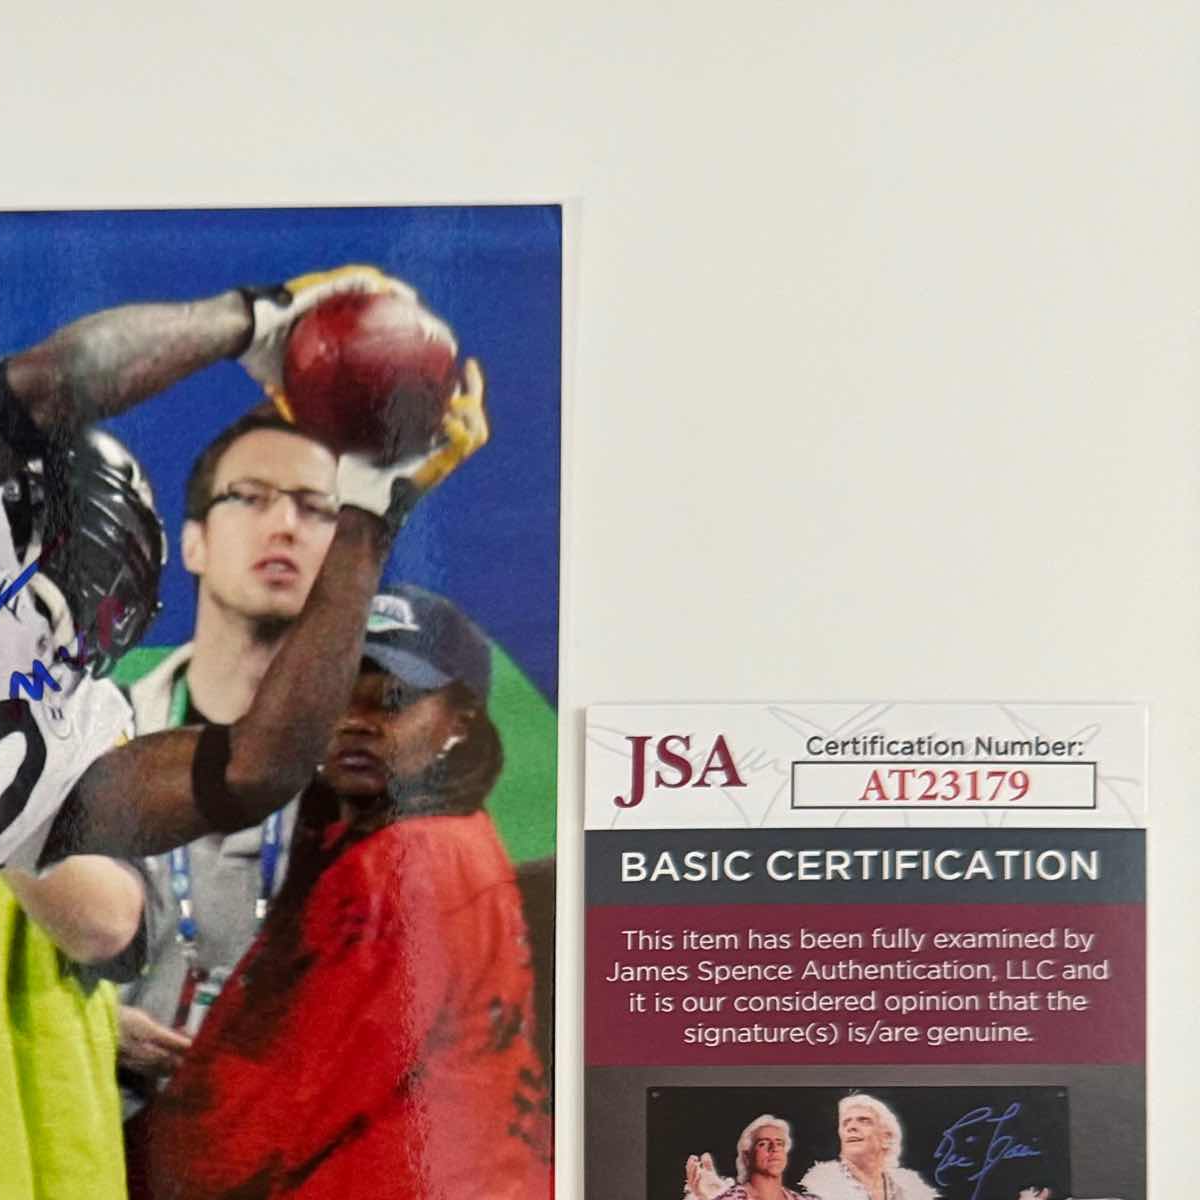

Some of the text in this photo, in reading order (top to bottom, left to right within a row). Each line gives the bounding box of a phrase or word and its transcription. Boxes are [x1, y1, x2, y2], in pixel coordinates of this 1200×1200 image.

[807, 736, 1083, 756] Certification Number:
[614, 735, 747, 808] JSA
[859, 769, 1029, 801] AT23179
[622, 850, 1098, 881] BASIC CERTIFICATION
[622, 928, 1094, 952] This item has been fully examined by
[606, 960, 1108, 984] James Spence Authentication, LLC and
[630, 991, 1088, 1014] it is our considered opinion that the
[684, 1020, 1034, 1046] signature(s) is/are genuine.
